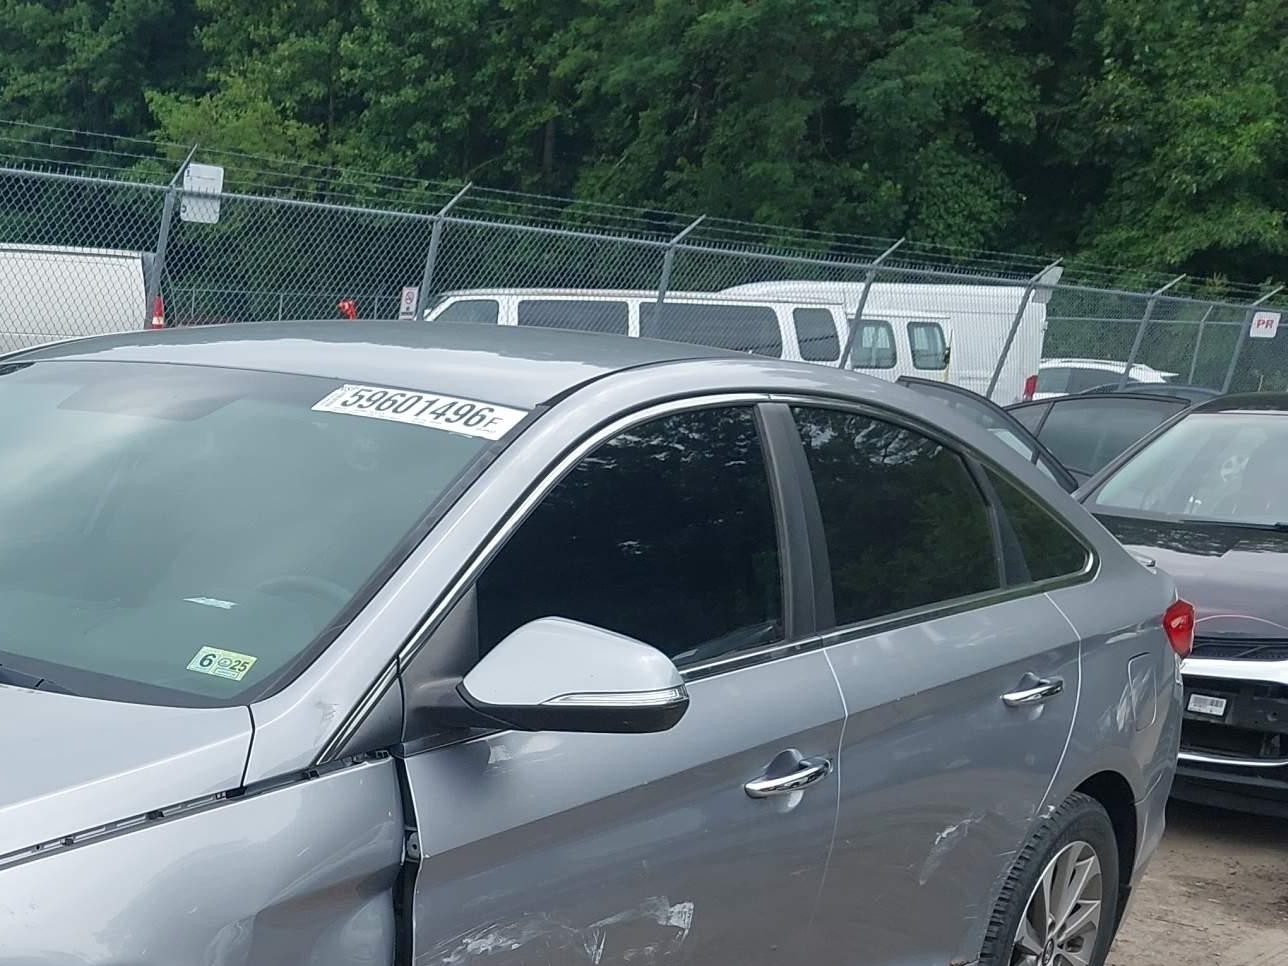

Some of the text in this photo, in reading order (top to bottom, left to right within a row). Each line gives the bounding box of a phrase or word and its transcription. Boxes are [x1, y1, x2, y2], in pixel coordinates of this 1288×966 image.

[1256, 319, 1274, 328] PR
[340, 388, 495, 428] 59601496
[199, 653, 249, 672] 6 25
